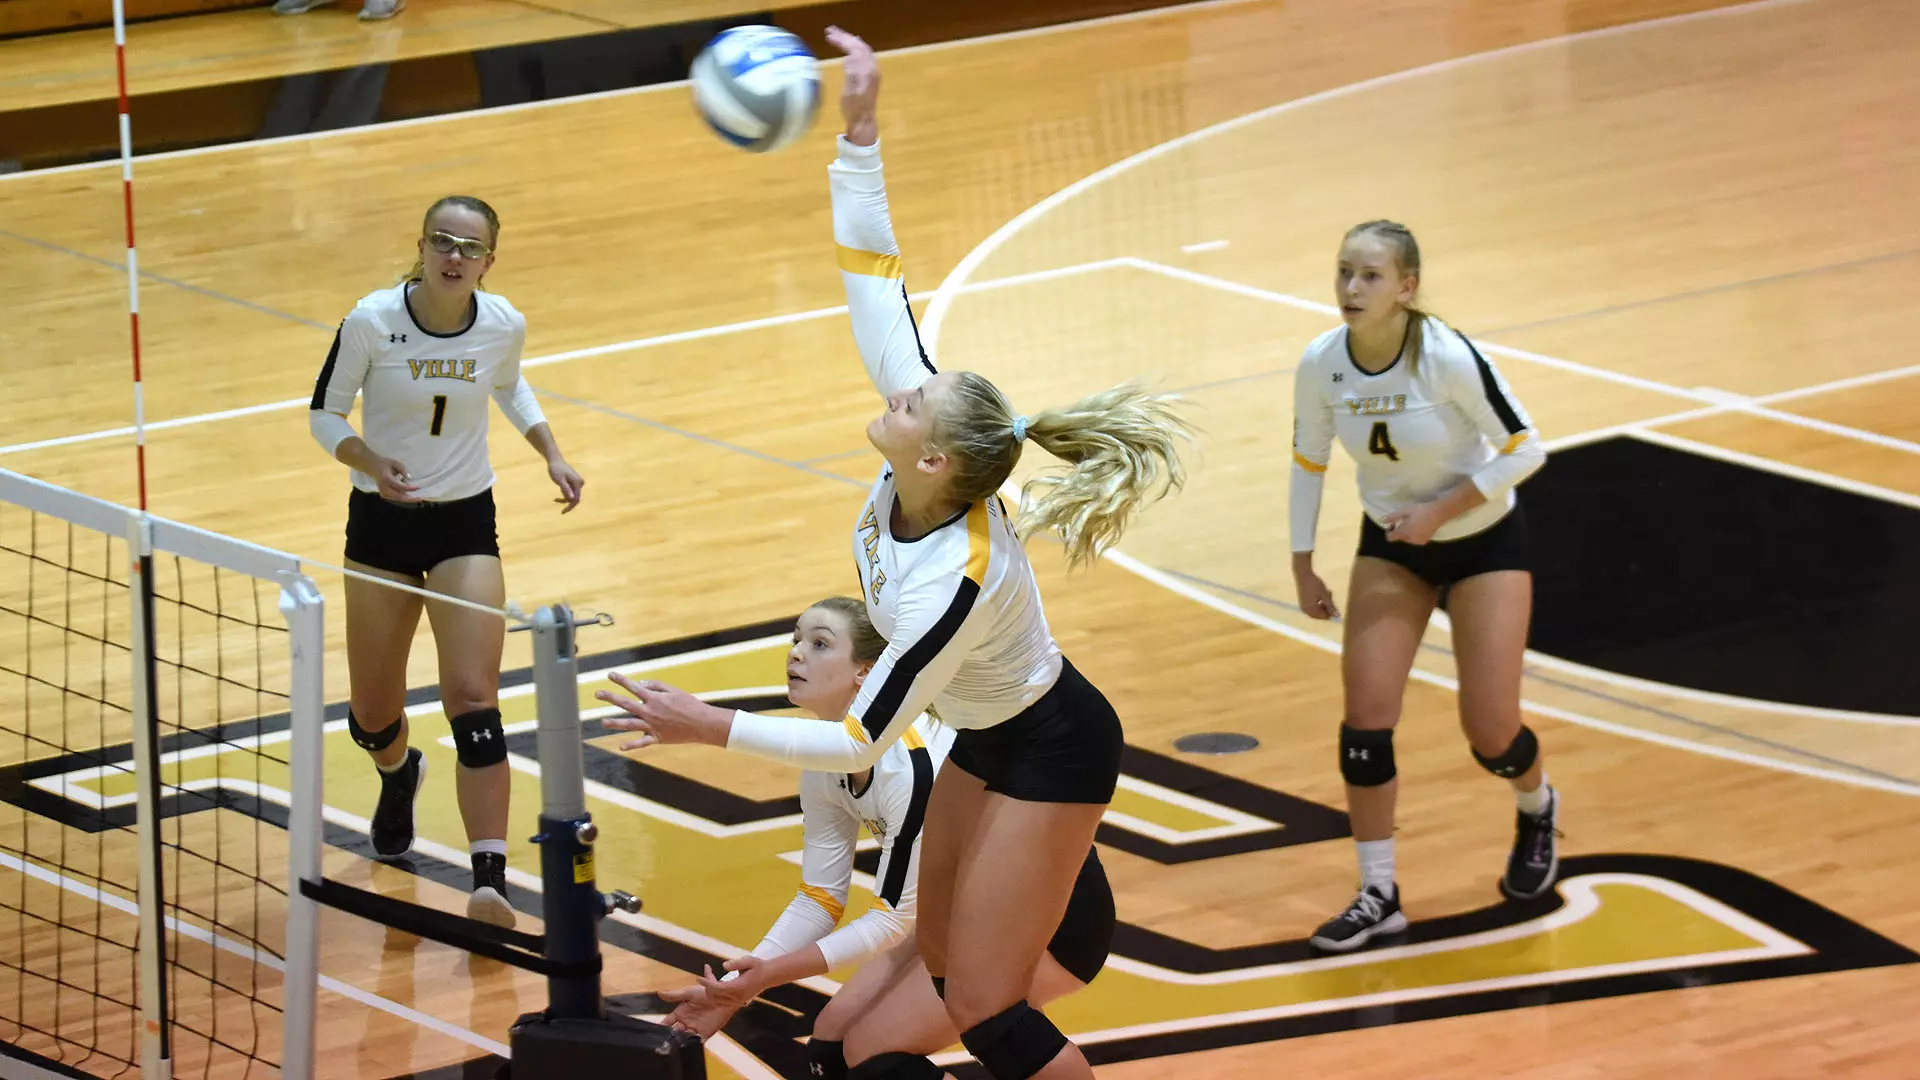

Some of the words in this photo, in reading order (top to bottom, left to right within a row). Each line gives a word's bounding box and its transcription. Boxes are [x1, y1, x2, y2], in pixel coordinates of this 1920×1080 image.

[407, 359, 477, 383] VILLE
[430, 395, 448, 436] 1
[1345, 394, 1406, 416] VILLE
[1369, 421, 1400, 461] 4
